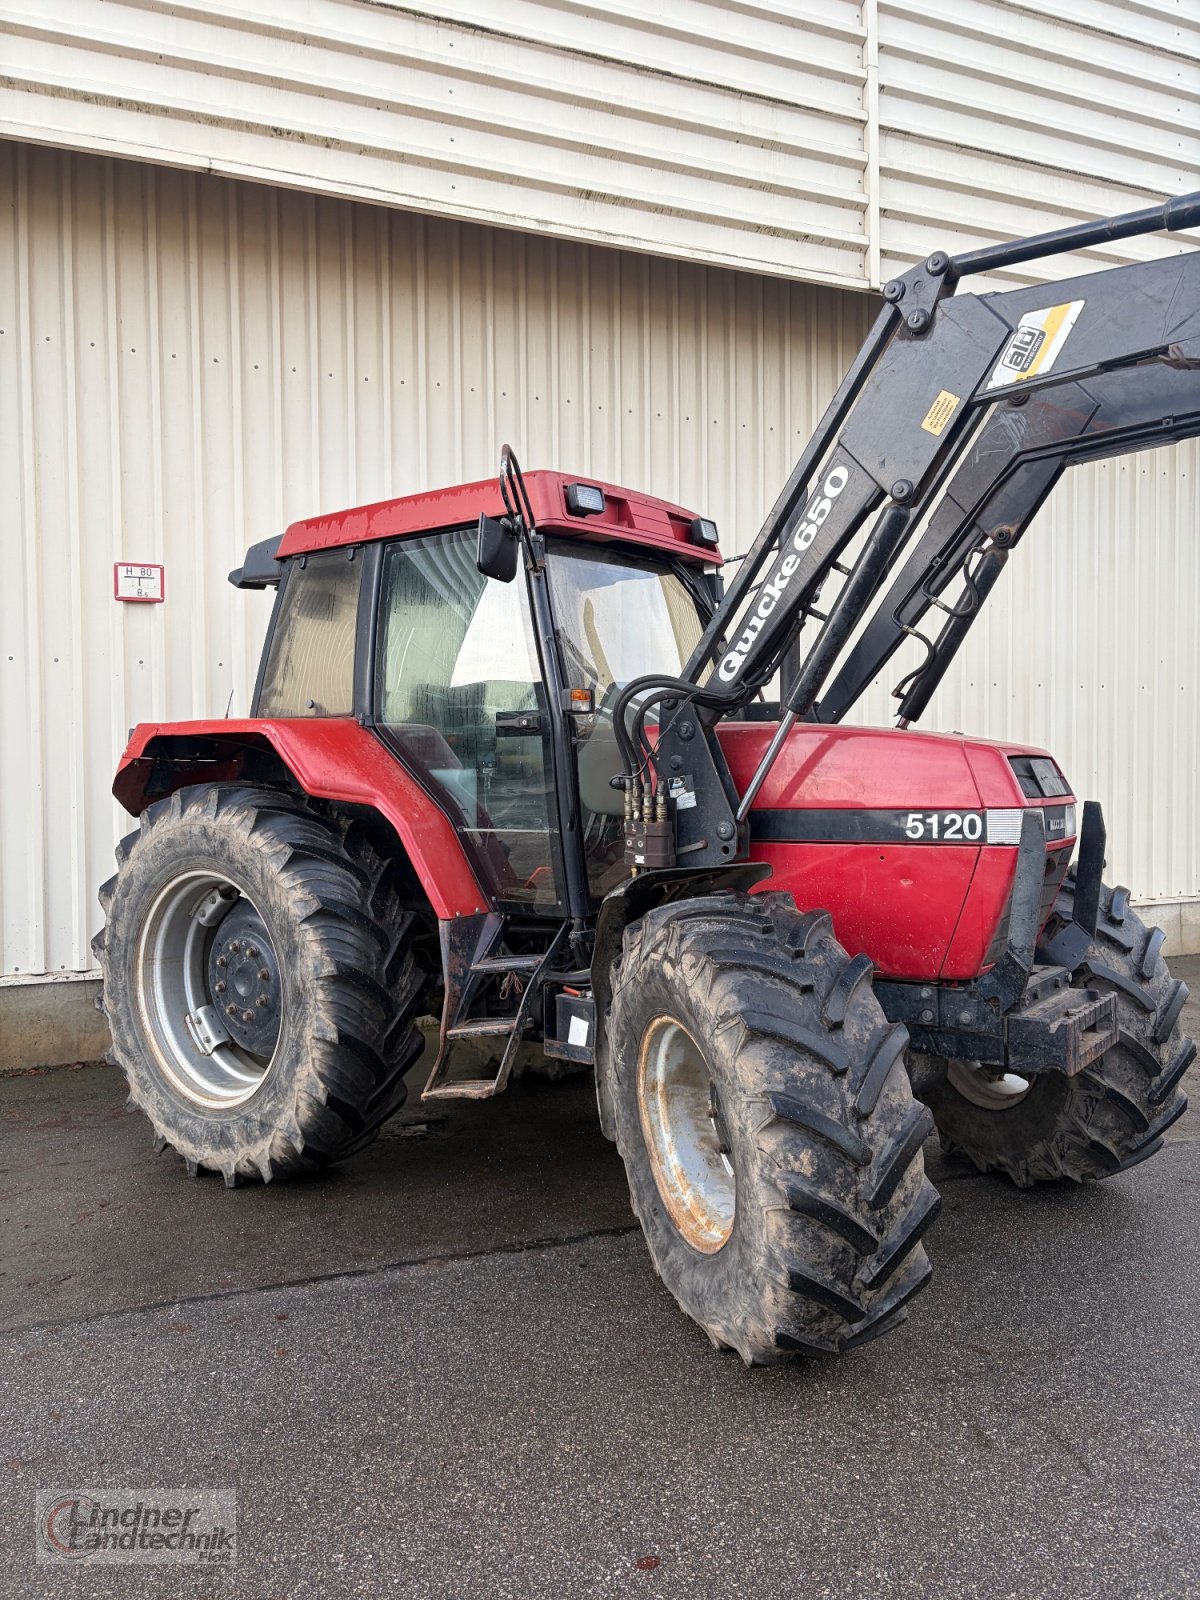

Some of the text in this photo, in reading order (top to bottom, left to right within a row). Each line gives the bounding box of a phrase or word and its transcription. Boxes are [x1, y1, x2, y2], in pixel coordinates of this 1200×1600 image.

[1023, 335, 1044, 369] SWEDEN
[126, 567, 152, 576] H 80
[718, 466, 849, 682] Quicke 650
[905, 813, 982, 840] 5120
